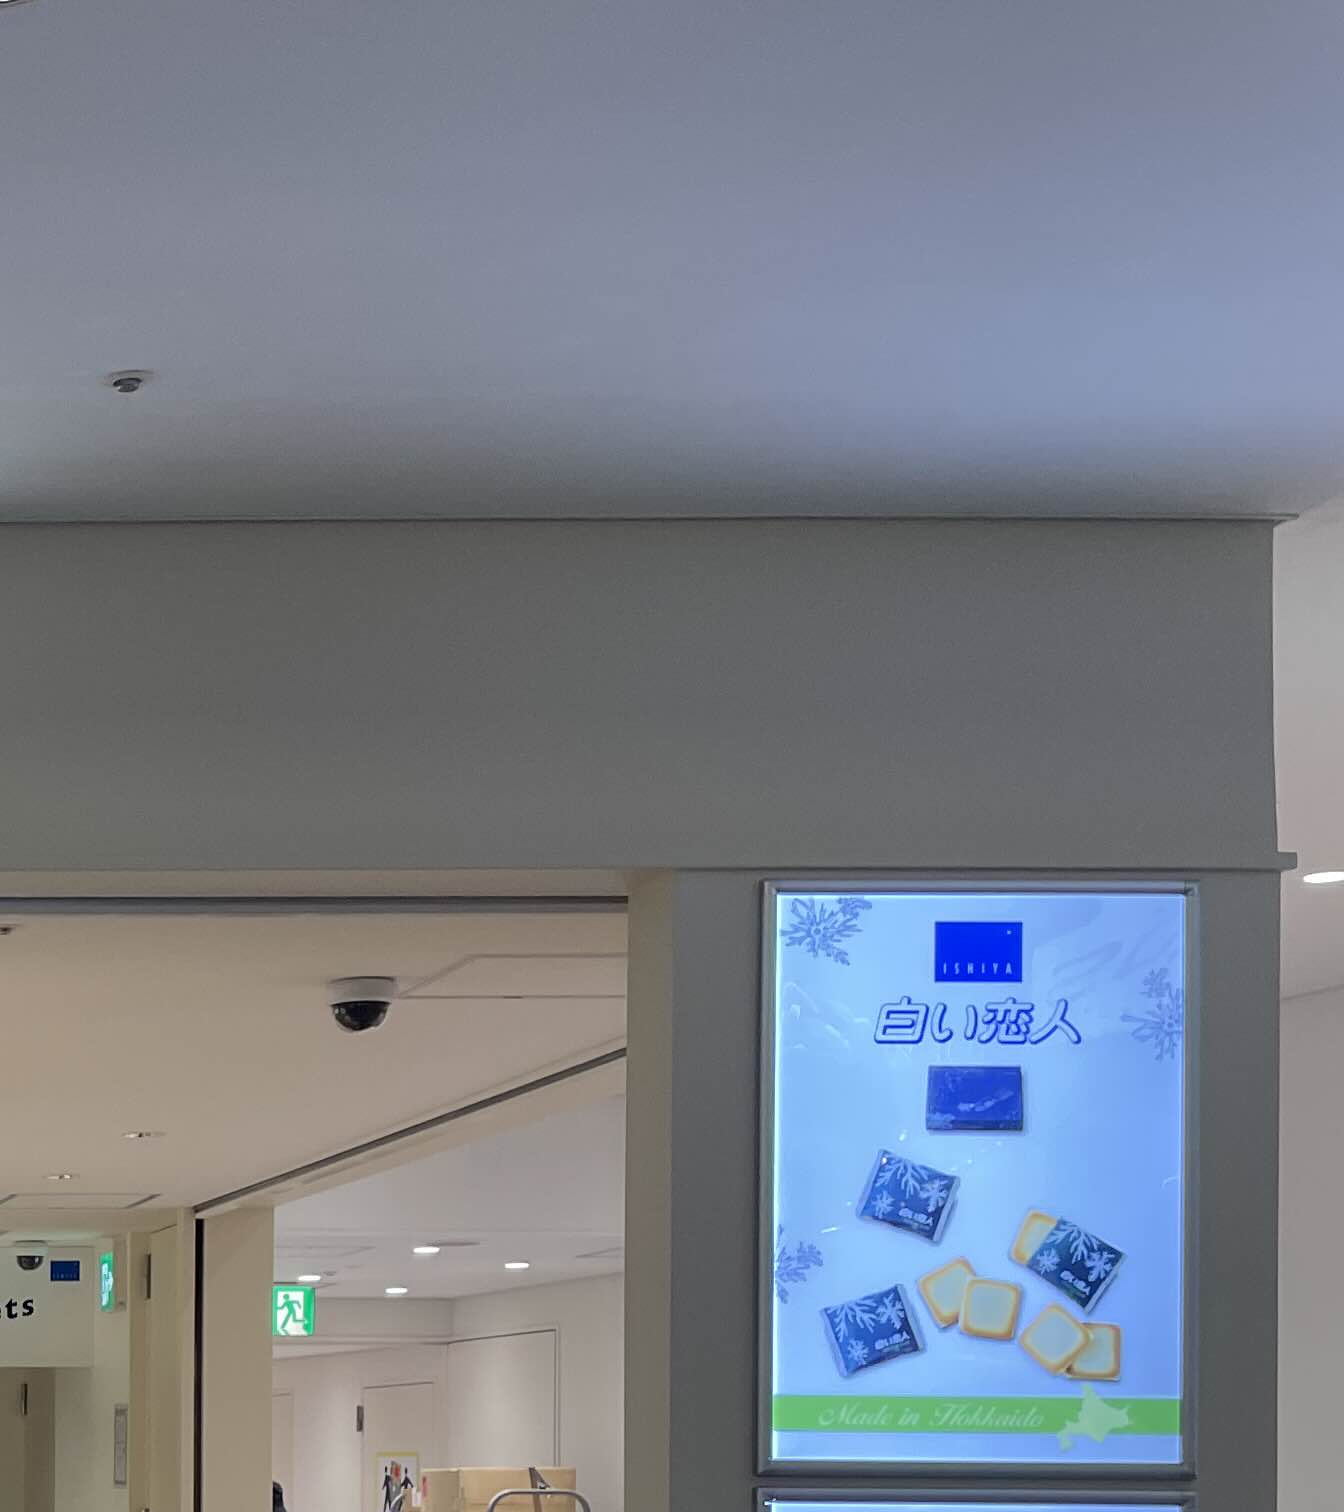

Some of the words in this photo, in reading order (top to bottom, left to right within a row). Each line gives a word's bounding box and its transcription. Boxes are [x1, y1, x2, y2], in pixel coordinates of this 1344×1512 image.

[942, 962, 1013, 975] ISHIYA
[874, 995, 1082, 1045] 白い恋人
[818, 1402, 890, 1426] Made
